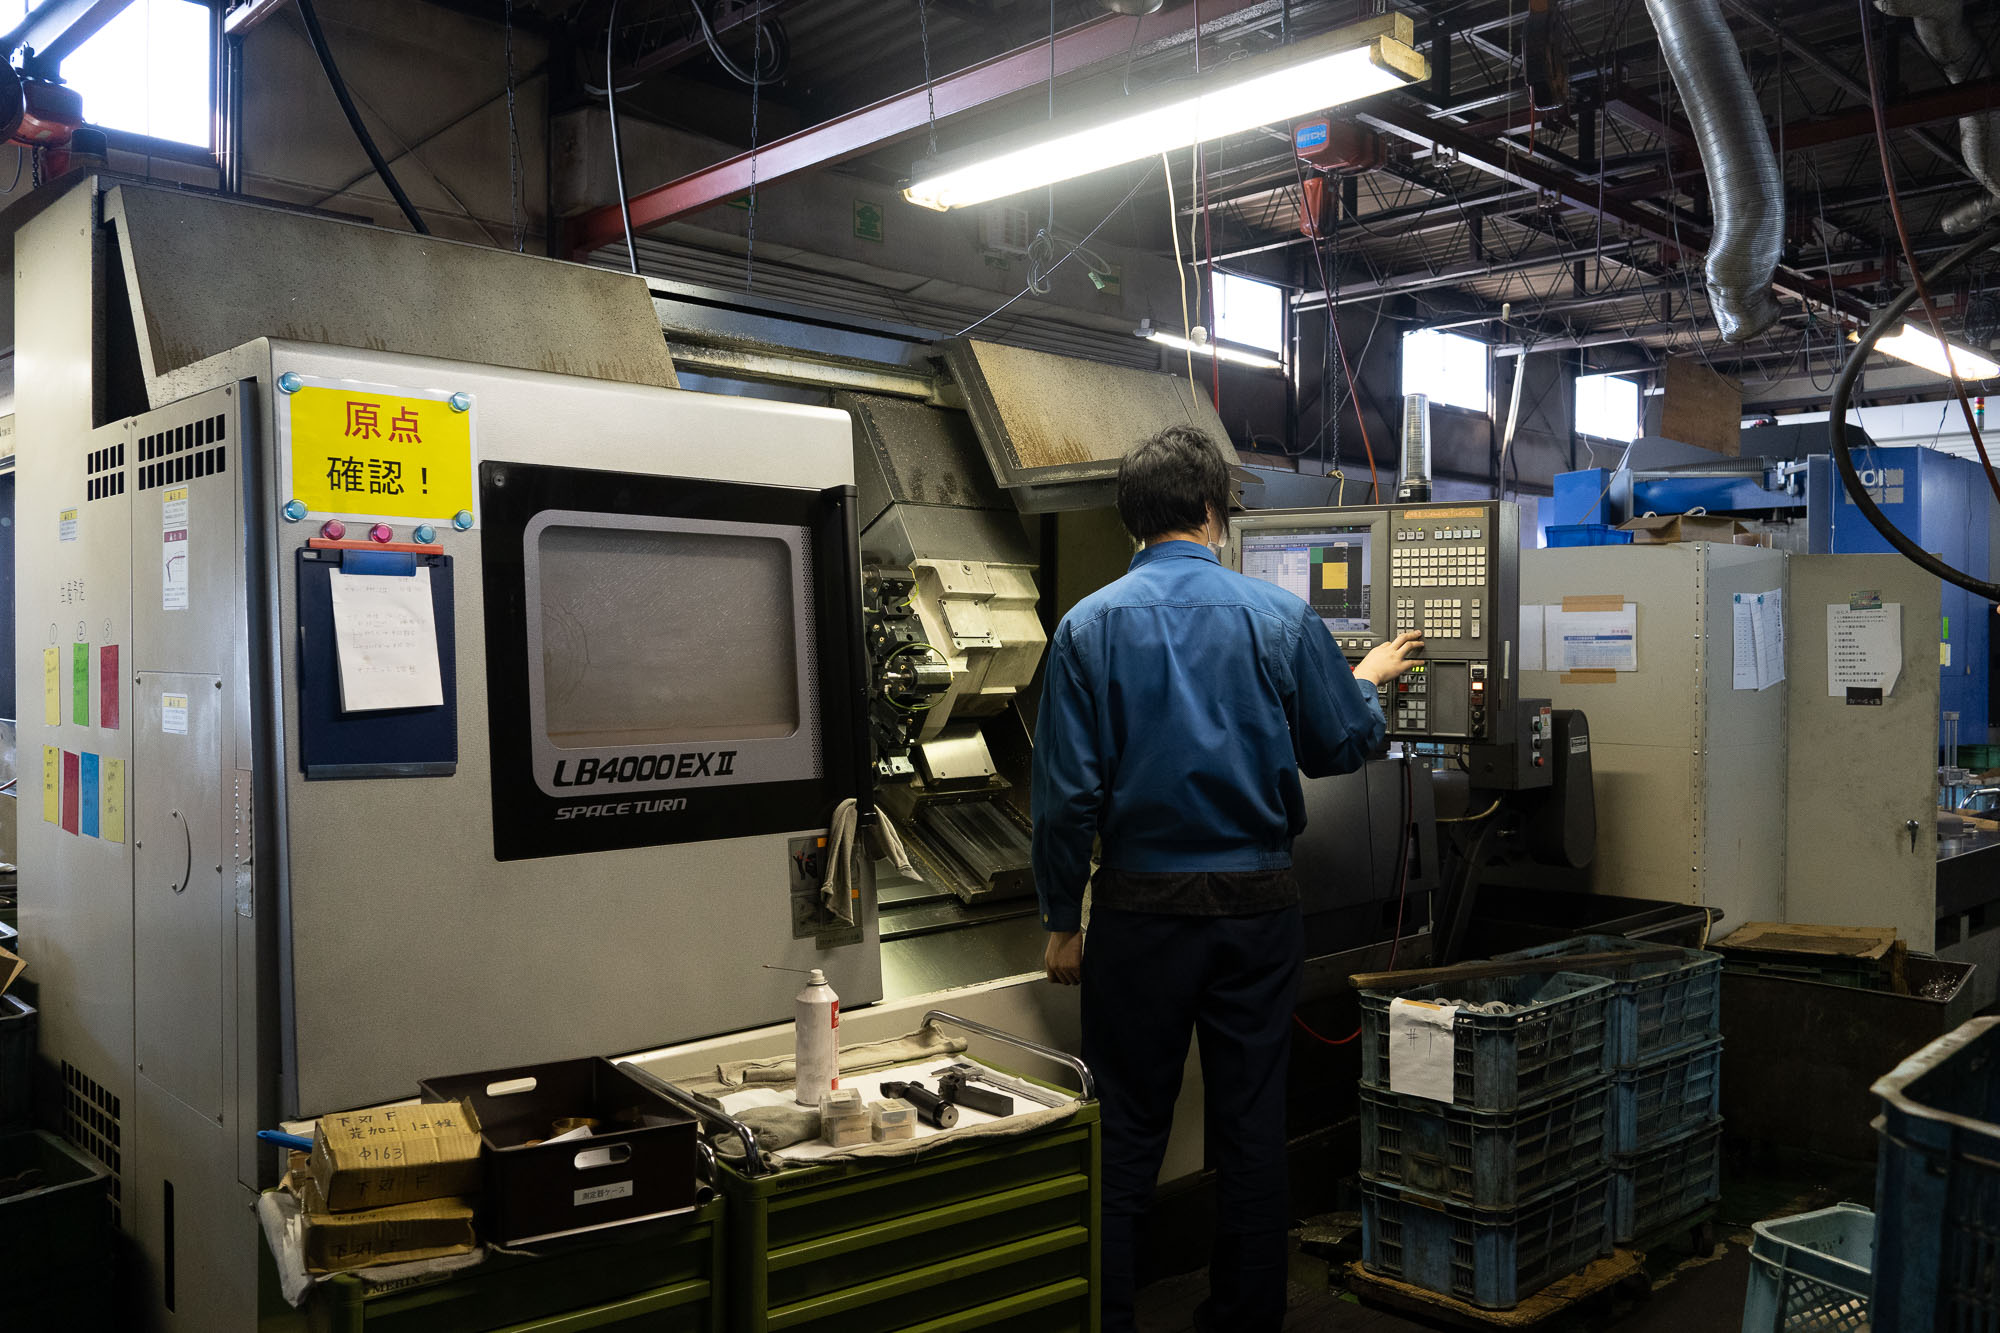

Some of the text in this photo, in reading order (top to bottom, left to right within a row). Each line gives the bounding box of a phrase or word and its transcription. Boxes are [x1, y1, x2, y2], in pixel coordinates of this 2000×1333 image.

[344, 401, 422, 444] 原点
[554, 797, 688, 821] SPACE TURN
